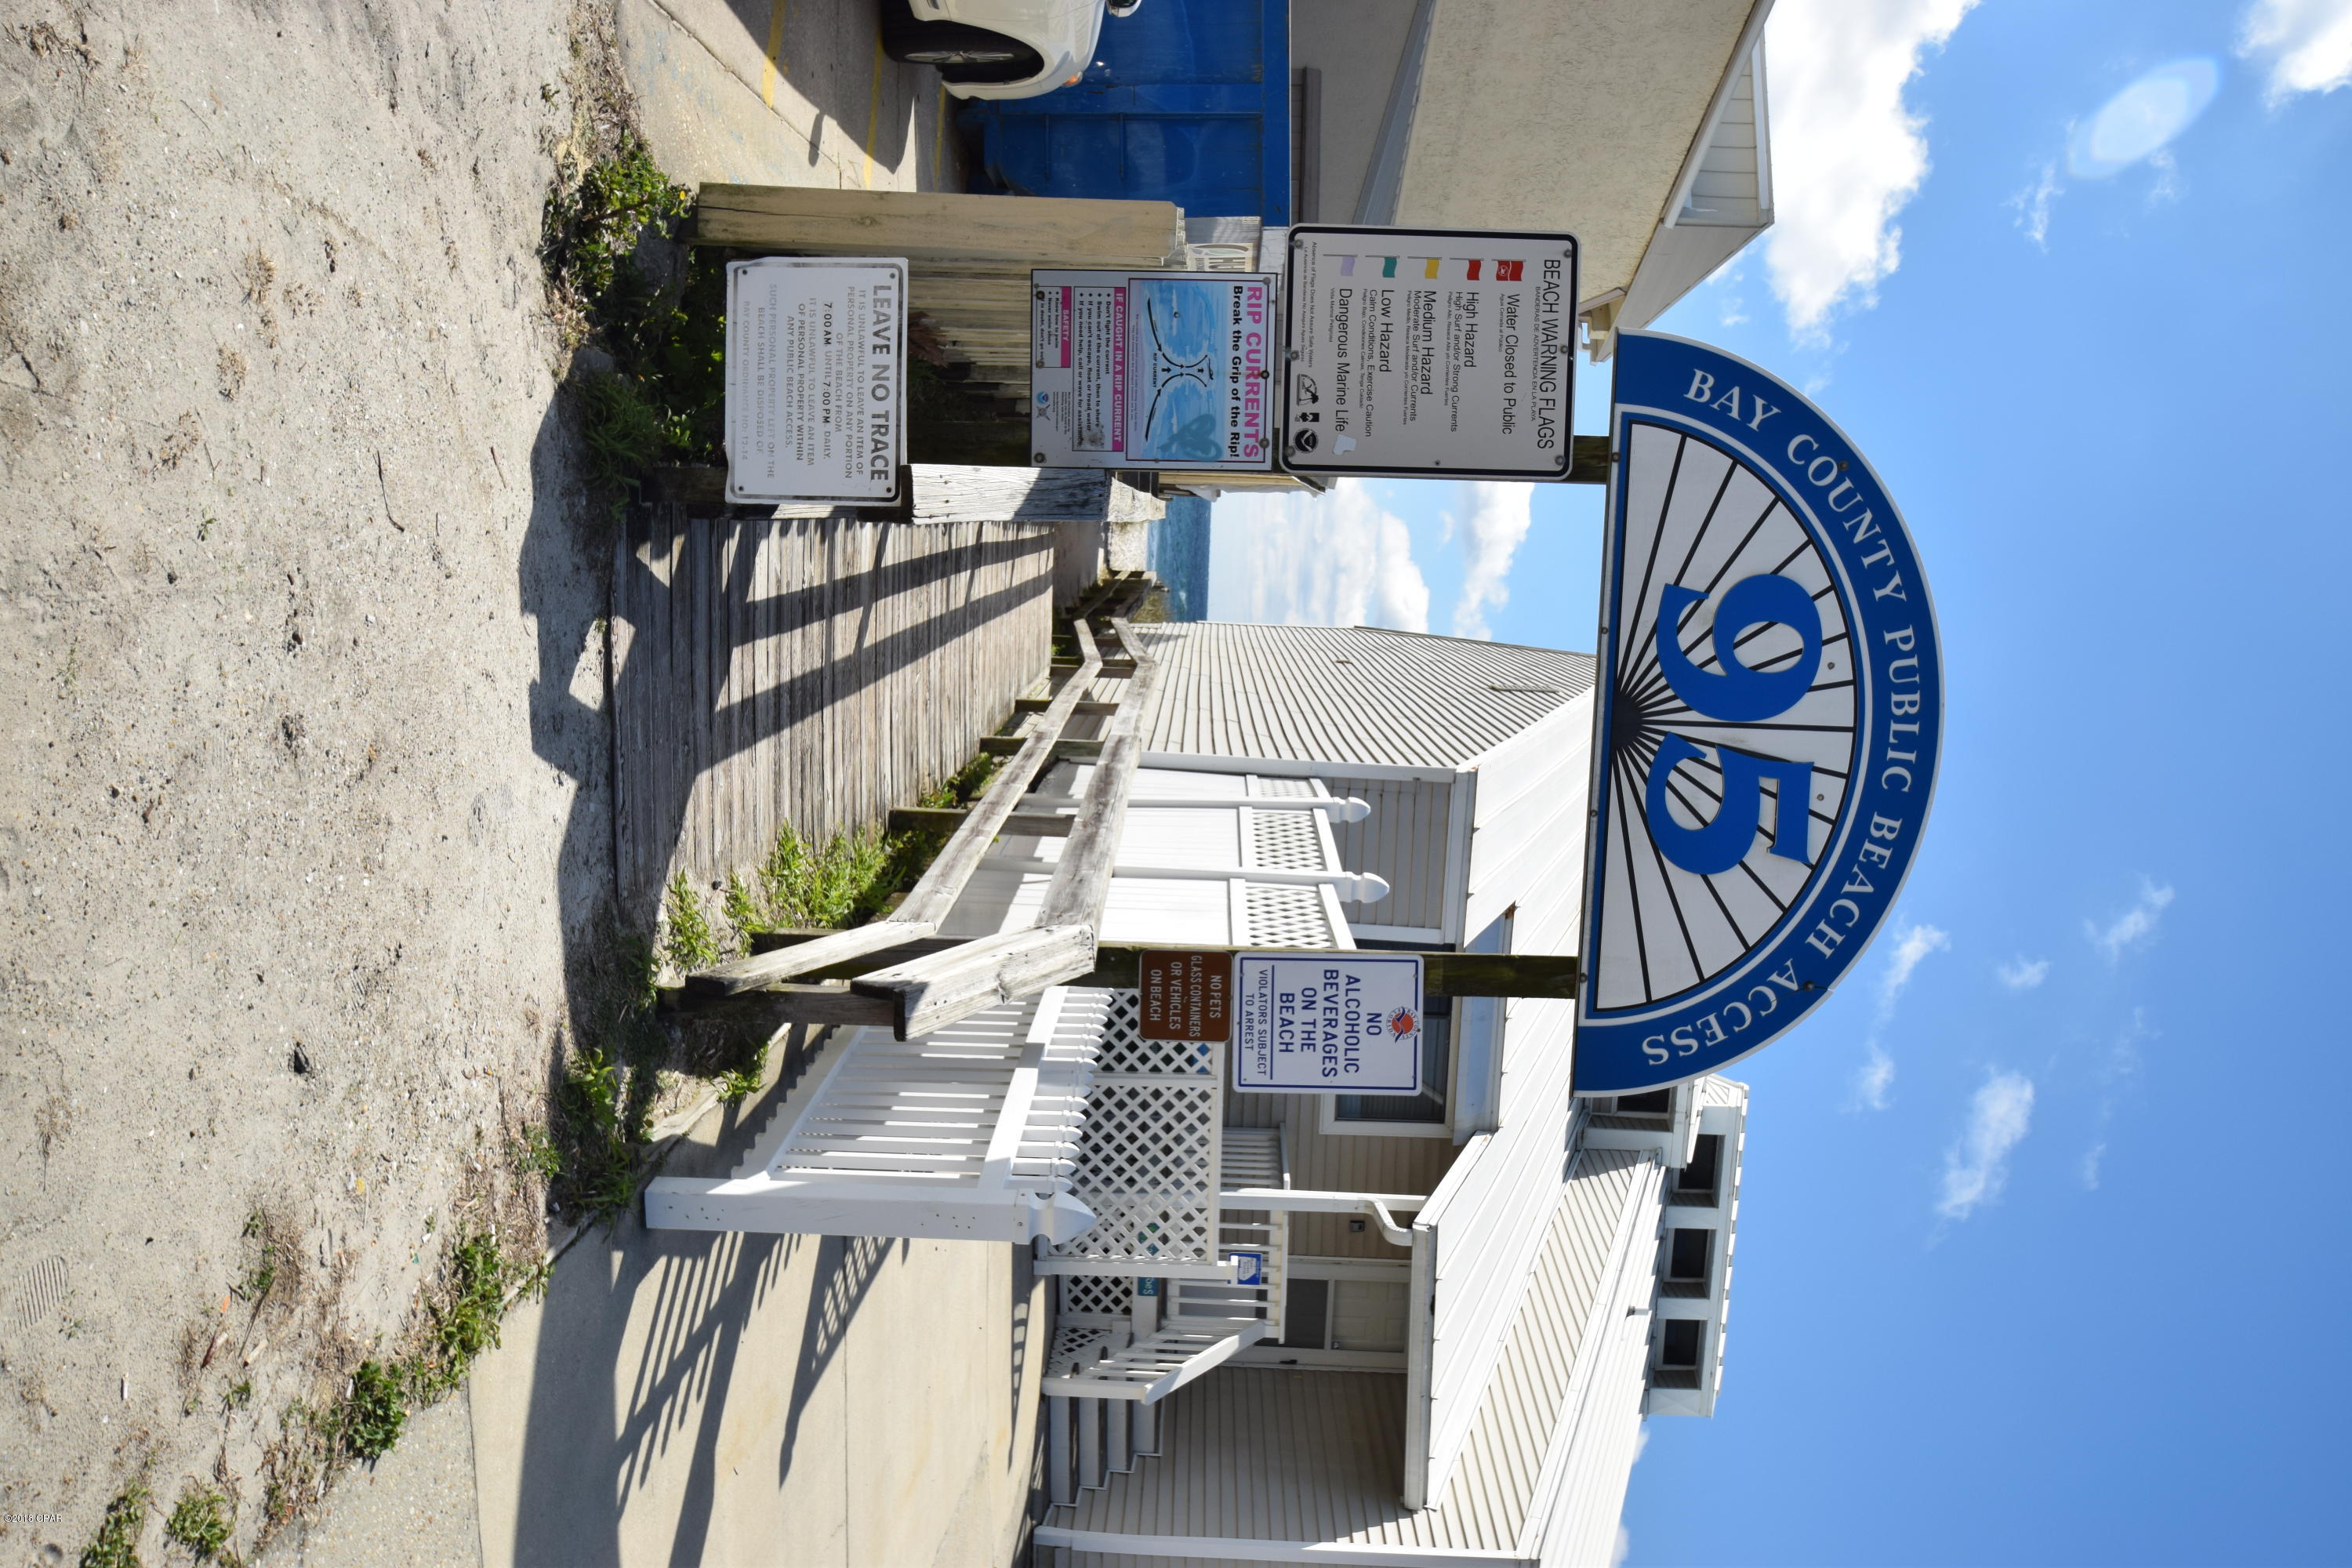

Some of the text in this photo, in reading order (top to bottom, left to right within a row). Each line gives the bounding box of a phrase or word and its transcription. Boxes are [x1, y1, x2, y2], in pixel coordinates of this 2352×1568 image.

[798, 303, 805, 315] OF
[809, 309, 816, 318] IS
[824, 302, 832, 328] 7:00
[1116, 293, 1123, 302] IF
[1379, 290, 1394, 372] Low Hazard
[1463, 292, 1479, 367] High Hazard
[836, 333, 843, 345] OF
[1115, 351, 1122, 360] IN
[1228, 286, 1243, 457] Break the Grip of the Rip!
[1244, 287, 1262, 457] RIP CURRENTS
[1335, 289, 1352, 432] Dangerous Marine Life
[1365, 289, 1377, 437] Calm Conditions, Exercise Caution
[1410, 291, 1421, 421] Moderate Surf and/or Currents
[1421, 291, 1436, 394] Medium Hazard
[1450, 292, 1463, 432] High Surf and/or Strong Currents
[1502, 294, 1519, 434] Water Closed to Public
[1537, 260, 1560, 449] BEACH WARNING FLAGS
[808, 378, 815, 390] TO
[846, 392, 853, 408] ON
[857, 370, 864, 382] TO
[870, 285, 891, 480] LEAVE NO TRACE
[808, 426, 815, 440] AN
[857, 419, 863, 432] AN
[856, 462, 863, 475] OF
[1639, 368, 1922, 1066] BAY COUNTY PUBLIC BEACH ACCESS
[1644, 572, 1824, 876] 95
[1150, 969, 1162, 1021] ON BEACH
[1169, 962, 1182, 1029] OR VEHICLES
[1189, 956, 1202, 1037] GLASS CONTAINERS
[1210, 975, 1222, 1018] NO PETS
[1245, 993, 1254, 1051] TO ARREST
[1258, 970, 1268, 1075] VIOLATORS SUBJECT
[1279, 993, 1295, 1052] BEACH
[1301, 988, 1317, 1052] ON THE
[1322, 969, 1338, 1078] BEVERAGES
[1344, 975, 1361, 1073] ALCOHOLIC
[1367, 1013, 1382, 1035] NO
